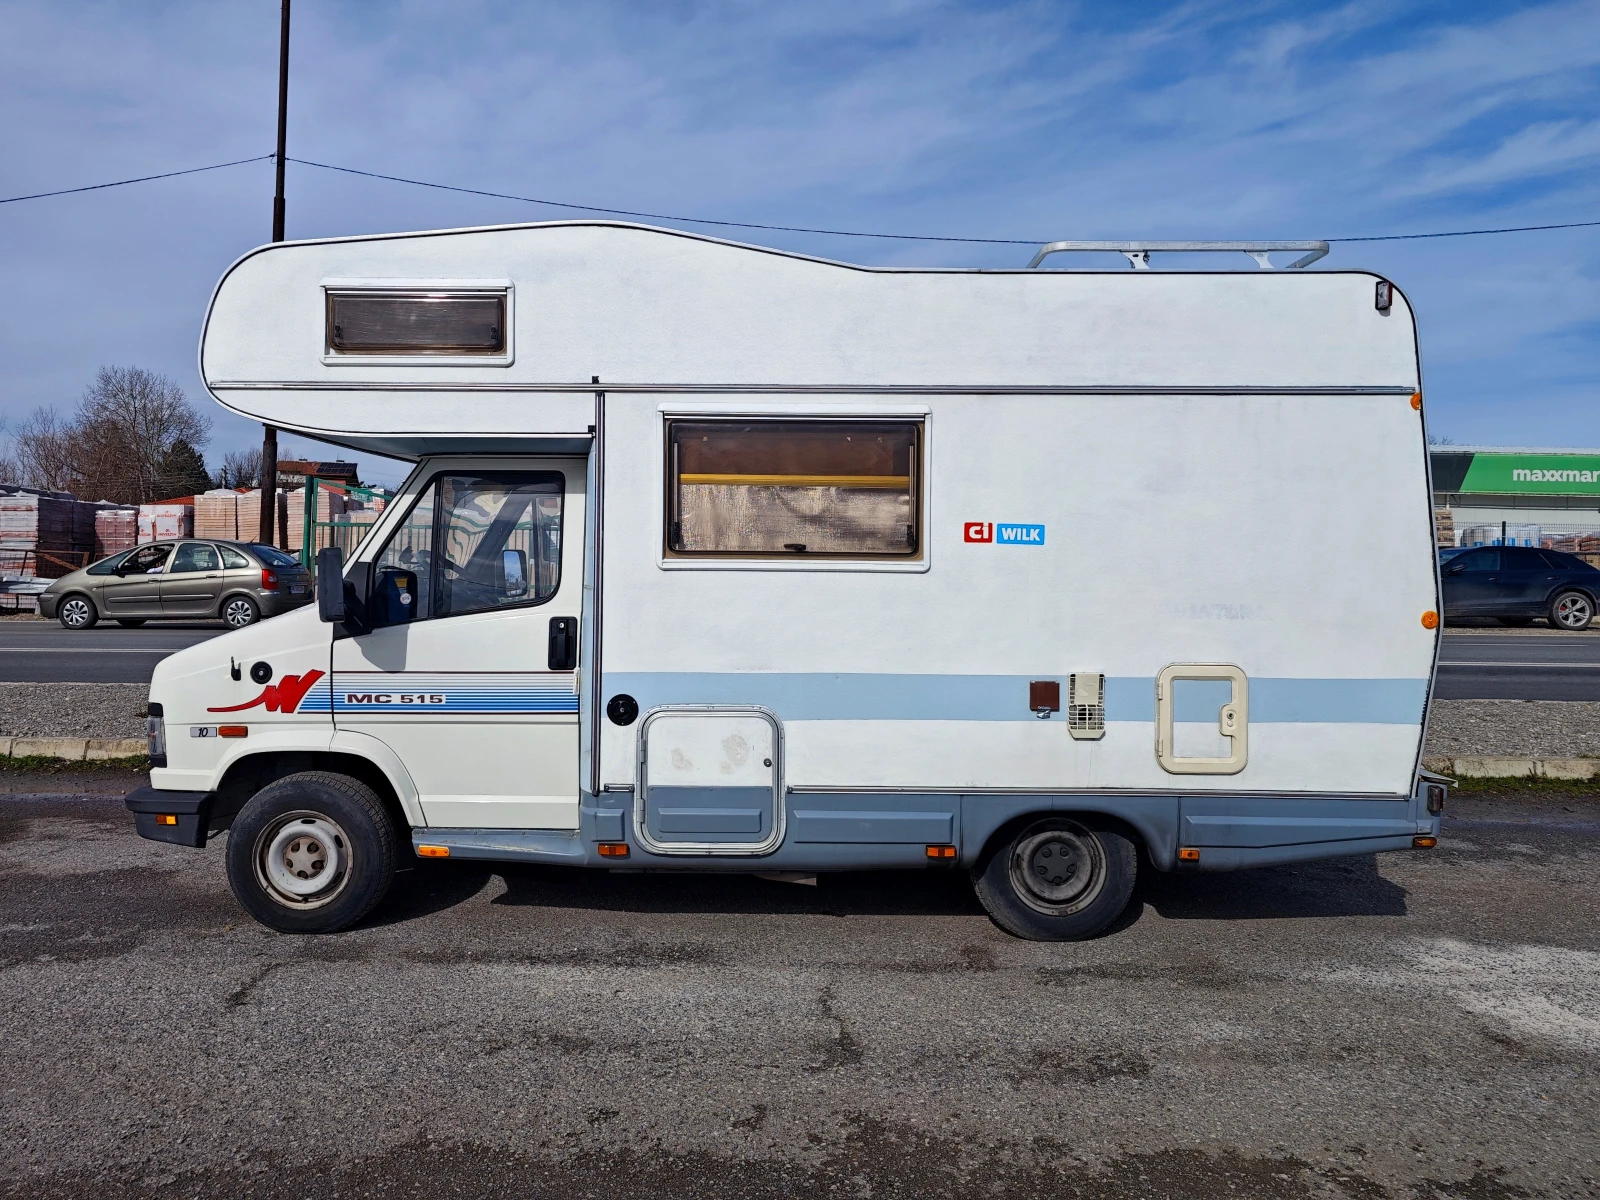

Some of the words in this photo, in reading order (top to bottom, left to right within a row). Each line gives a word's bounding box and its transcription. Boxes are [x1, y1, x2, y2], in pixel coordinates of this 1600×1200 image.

[1513, 469, 1600, 482] maxxmar
[1001, 527, 1040, 541] WILK
[347, 694, 392, 704] MC
[400, 695, 443, 704] 515
[198, 727, 208, 737] 10
